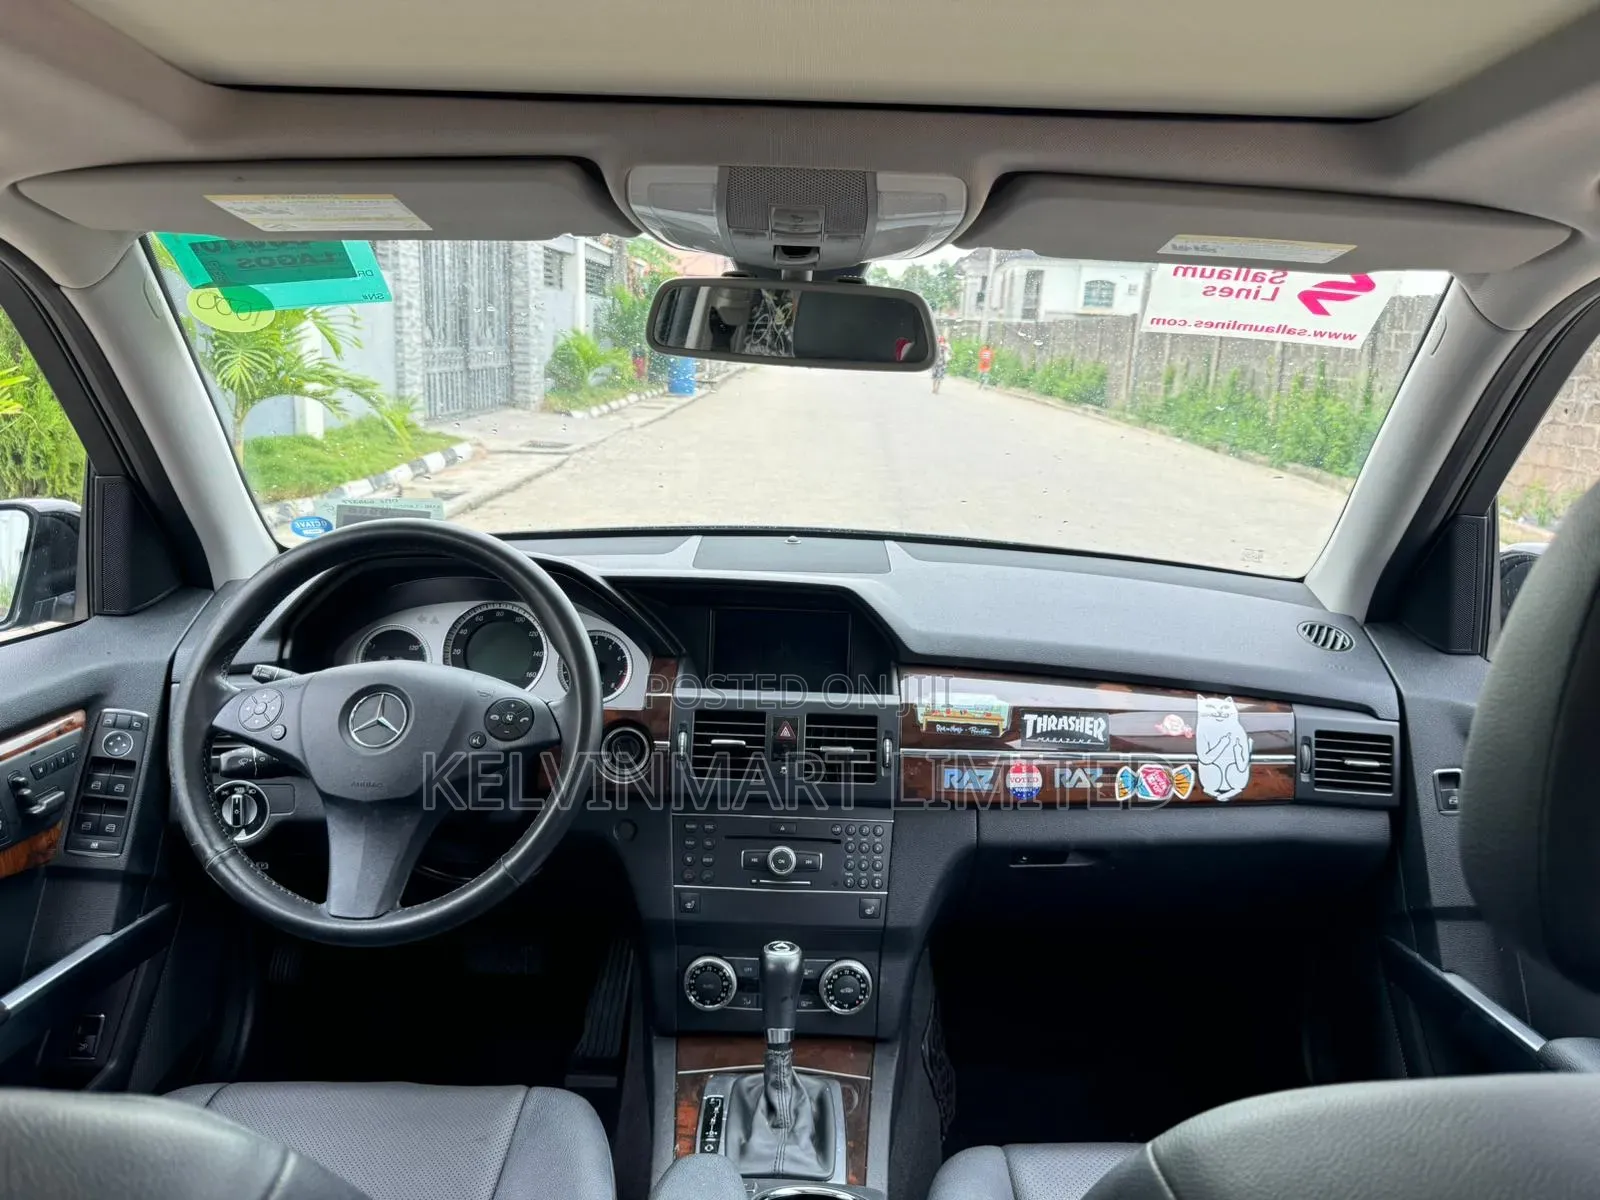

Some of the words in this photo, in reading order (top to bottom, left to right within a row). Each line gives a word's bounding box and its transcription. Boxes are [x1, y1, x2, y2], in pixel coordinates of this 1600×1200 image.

[1023, 713, 1106, 742] THRASHER
[944, 768, 993, 790] RAZ
[1054, 768, 1103, 788] RAZ
